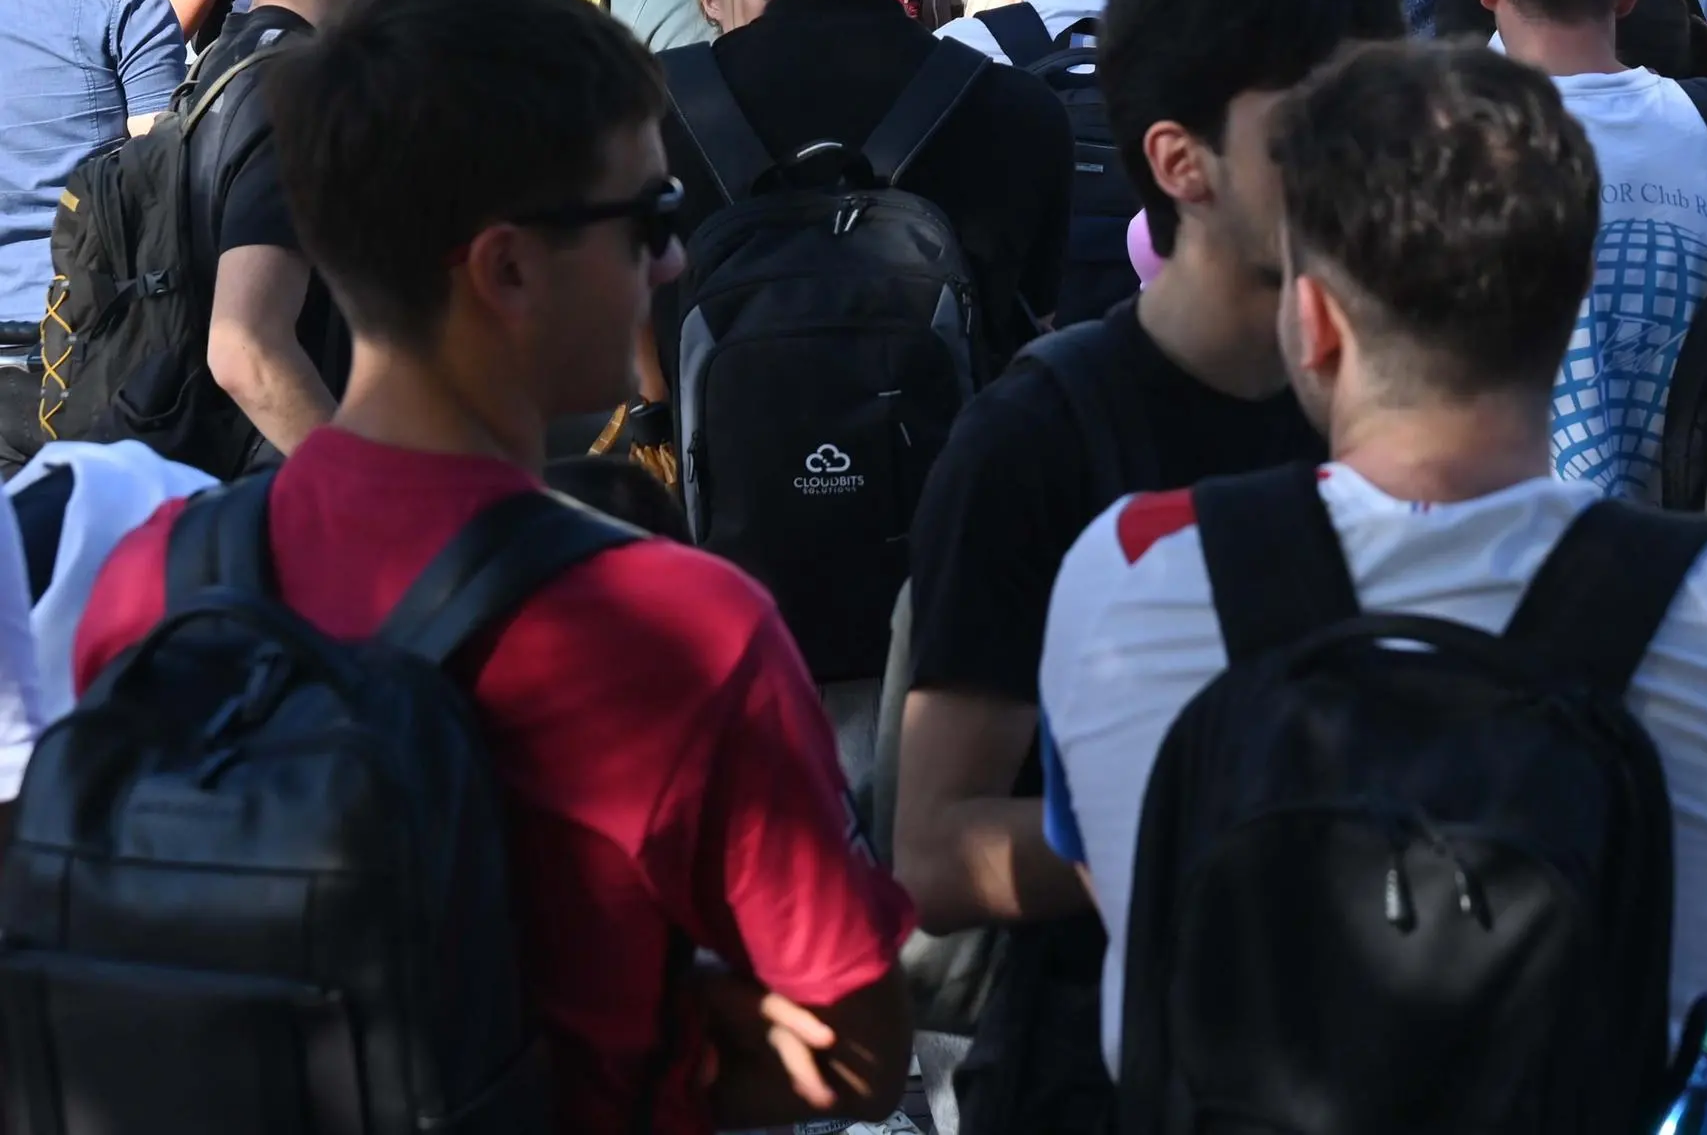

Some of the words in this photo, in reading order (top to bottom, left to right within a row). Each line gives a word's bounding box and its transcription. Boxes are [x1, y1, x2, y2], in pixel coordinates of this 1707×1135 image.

[1601, 182, 1635, 204] OR
[1640, 182, 1690, 209] Club
[793, 475, 865, 488] CLOUDBITS
